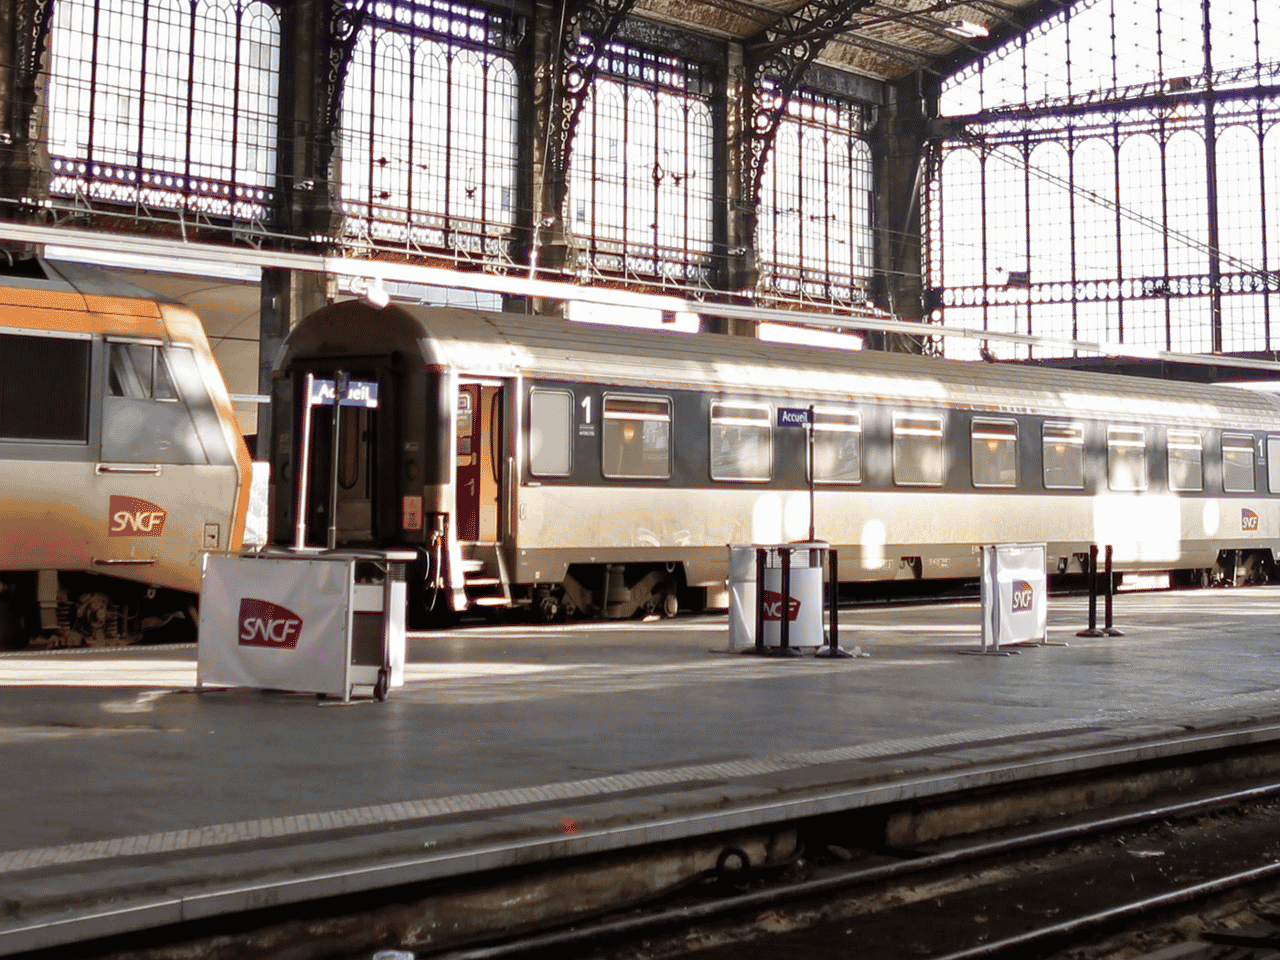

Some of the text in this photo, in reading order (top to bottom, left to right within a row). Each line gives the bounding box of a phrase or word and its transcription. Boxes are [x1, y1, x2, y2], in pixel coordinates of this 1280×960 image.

[319, 383, 370, 400] Acueil
[581, 396, 591, 424] 1
[782, 411, 808, 423] Accueil
[1258, 439, 1263, 457] 1
[111, 511, 164, 533] SNCF
[1242, 516, 1258, 529] SNCF
[1013, 590, 1032, 609] SNCF
[763, 601, 798, 618] NCF
[241, 617, 299, 643] SNCF
